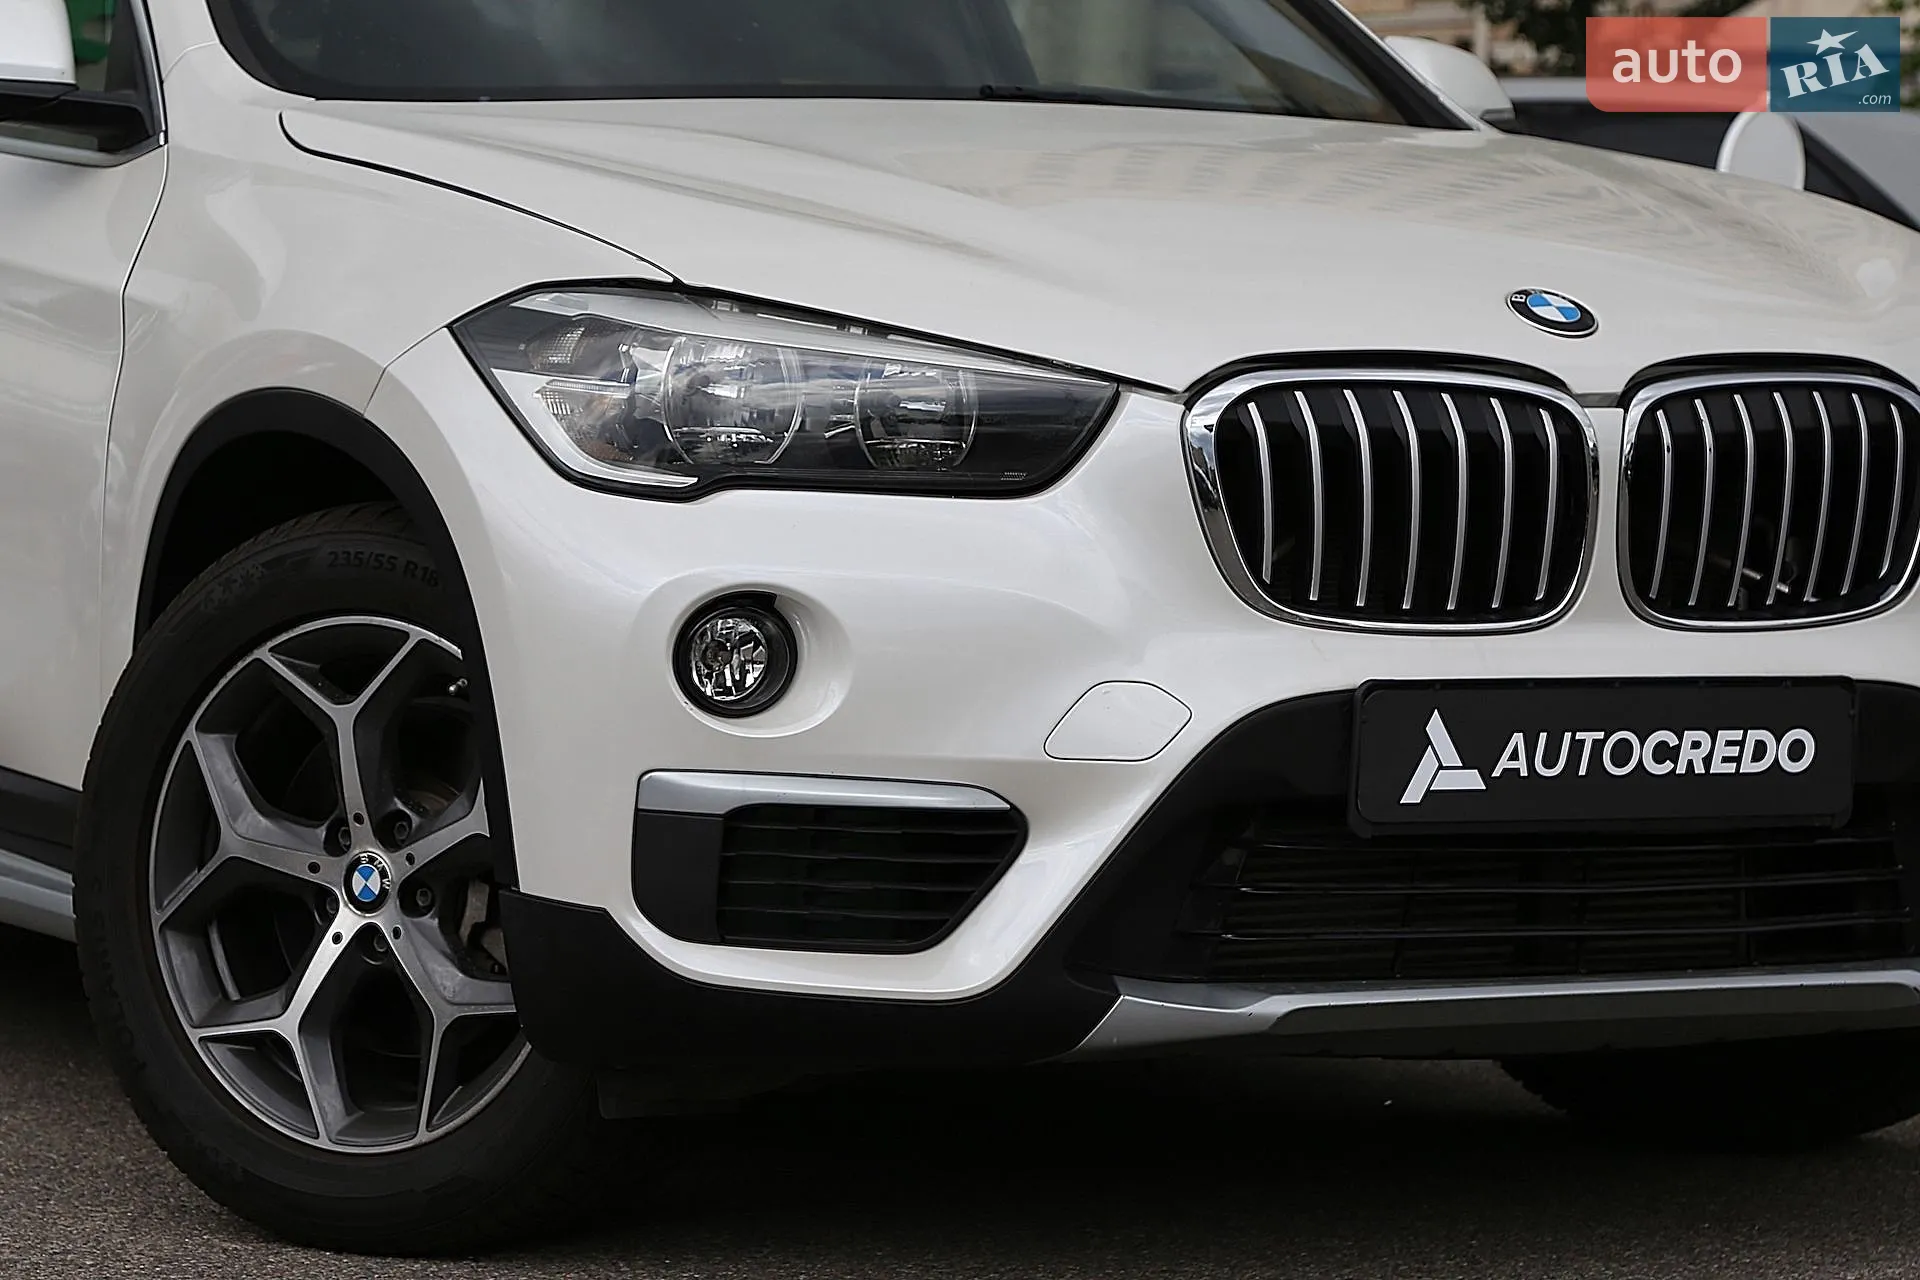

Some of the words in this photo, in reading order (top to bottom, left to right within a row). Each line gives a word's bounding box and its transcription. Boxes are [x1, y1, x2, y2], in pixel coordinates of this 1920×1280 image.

[328, 551, 398, 573] 235/55
[402, 560, 440, 588] R18
[1491, 728, 1815, 777] AUTOCREDO
[359, 853, 391, 890] BMW
